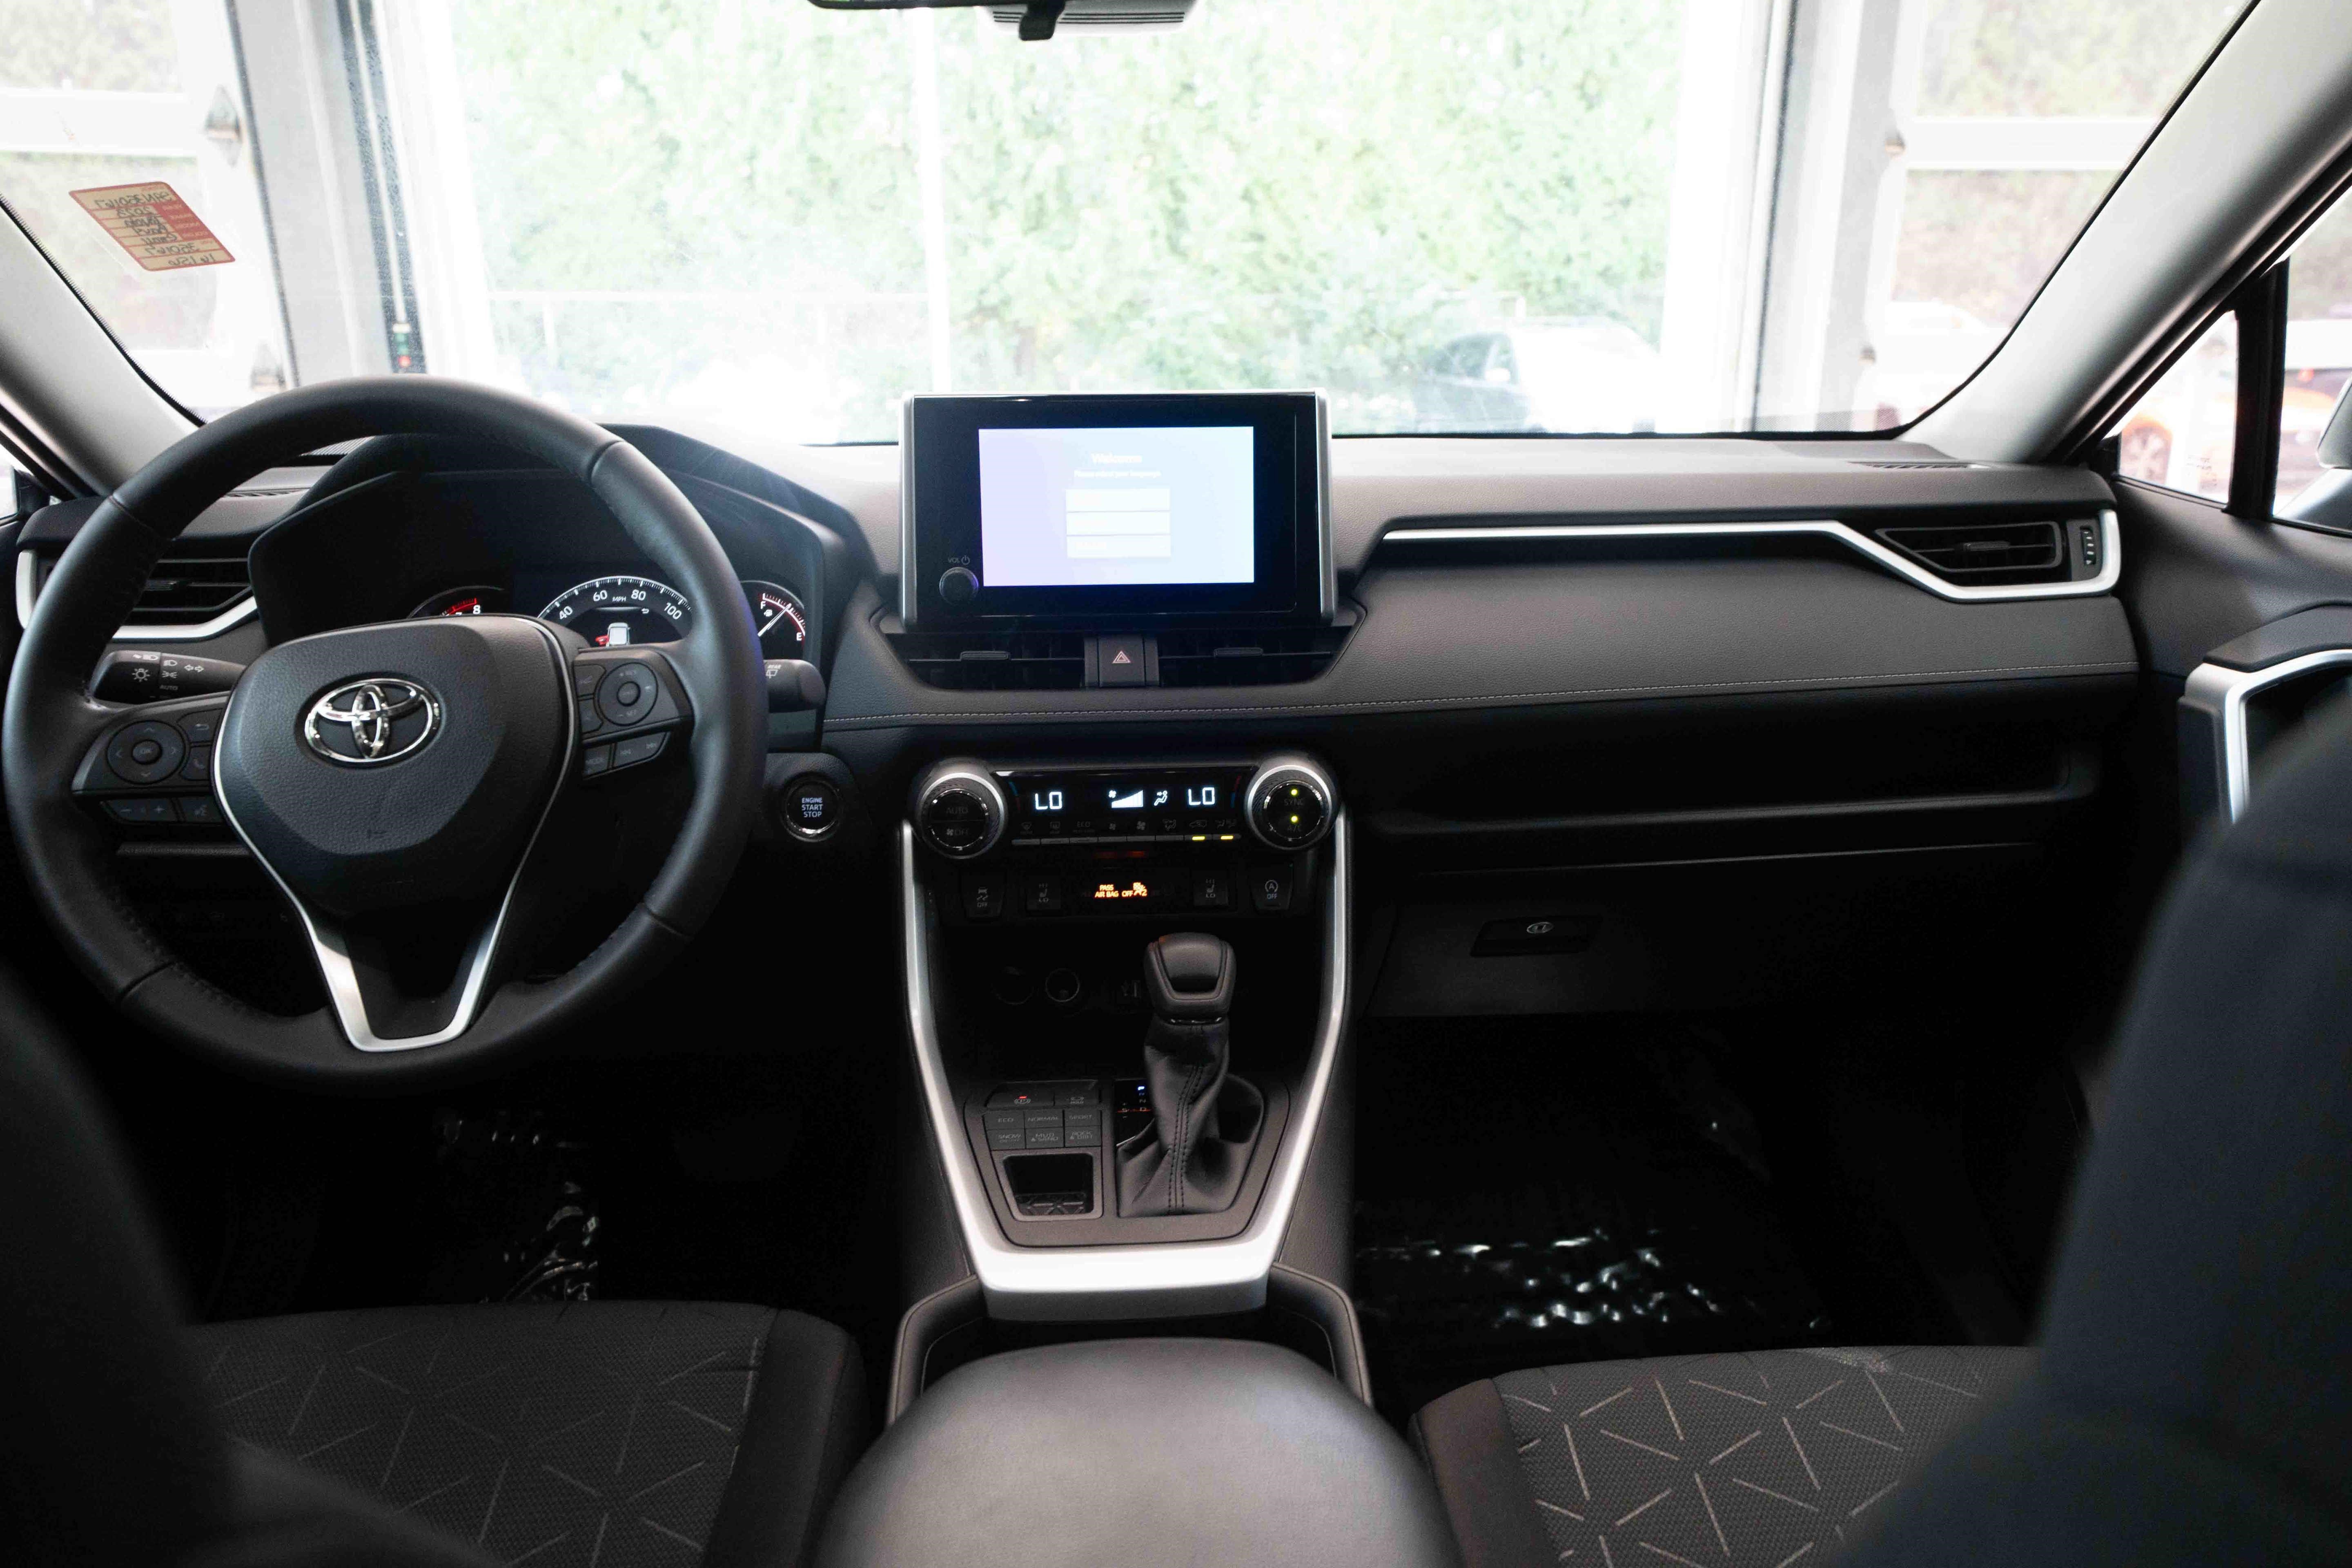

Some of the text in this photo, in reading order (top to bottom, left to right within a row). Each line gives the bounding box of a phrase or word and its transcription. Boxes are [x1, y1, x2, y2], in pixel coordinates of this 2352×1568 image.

[593, 590, 608, 602] 60
[631, 589, 646, 601] 80
[473, 604, 481, 615] 8
[664, 602, 682, 619] 100
[760, 601, 766, 609] F
[559, 606, 573, 619] 40
[796, 632, 802, 641] E
[1035, 791, 1062, 810] LO
[1188, 786, 1215, 806] LO
